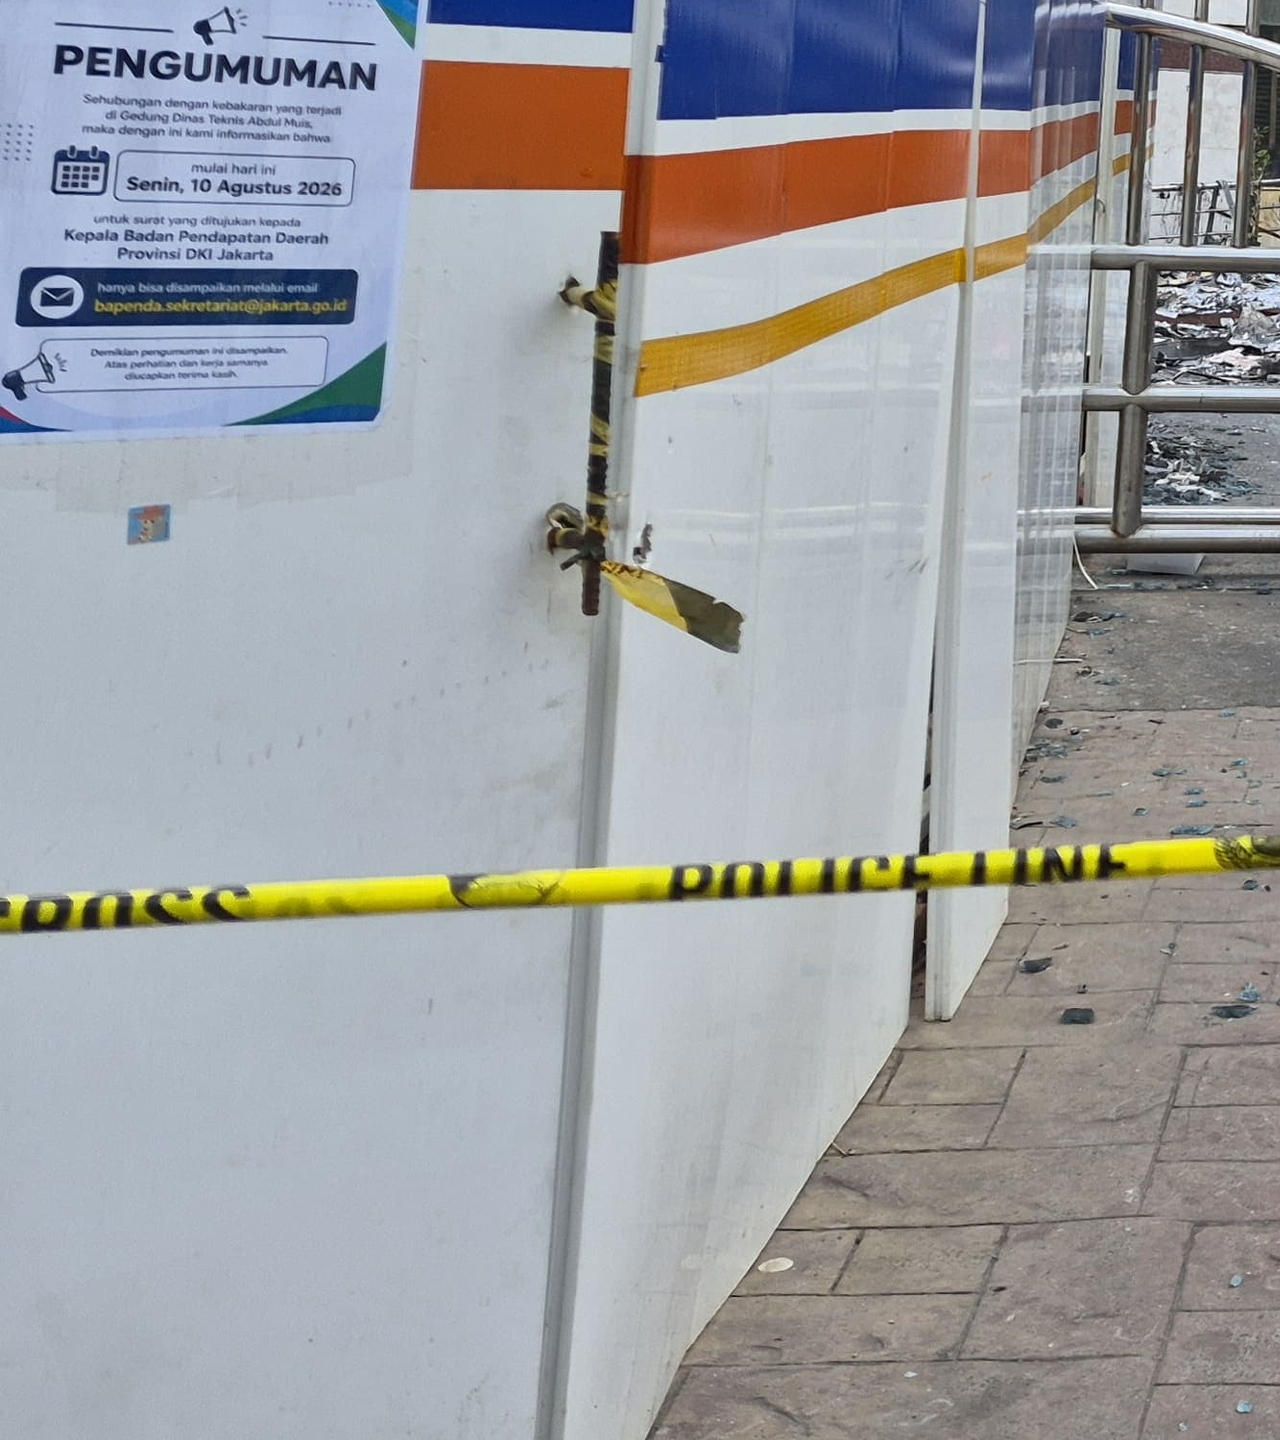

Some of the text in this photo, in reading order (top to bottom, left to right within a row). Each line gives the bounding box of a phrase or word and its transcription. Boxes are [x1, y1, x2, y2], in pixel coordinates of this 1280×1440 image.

[53, 45, 377, 91] PENGUMUMAN
[83, 94, 161, 109] Sehubungan
[164, 98, 209, 111] dengan
[212, 100, 272, 112] kebakaran
[275, 105, 303, 116] yang
[105, 110, 117, 120] di
[120, 110, 169, 124] Gedung
[172, 113, 204, 123] Dinas
[209, 114, 244, 126] Teknis
[247, 116, 281, 127] Abdul
[82, 124, 331, 143] maka dengan ini kami informasikan bahwa
[191, 163, 276, 176] mulai hari ini
[126, 177, 342, 198] Senin, 10 Agustus 2026
[93, 214, 301, 228] untuk surat yang ditujukan kepada
[64, 229, 329, 245] Kepala Badan Pendapatan Daerah
[117, 247, 274, 261] Provinsi DKI Jakarta
[97, 282, 318, 295] hanya bisa disampaikan melalui email
[95, 299, 348, 315] bapenda.sekretariat@jakarta.go.id
